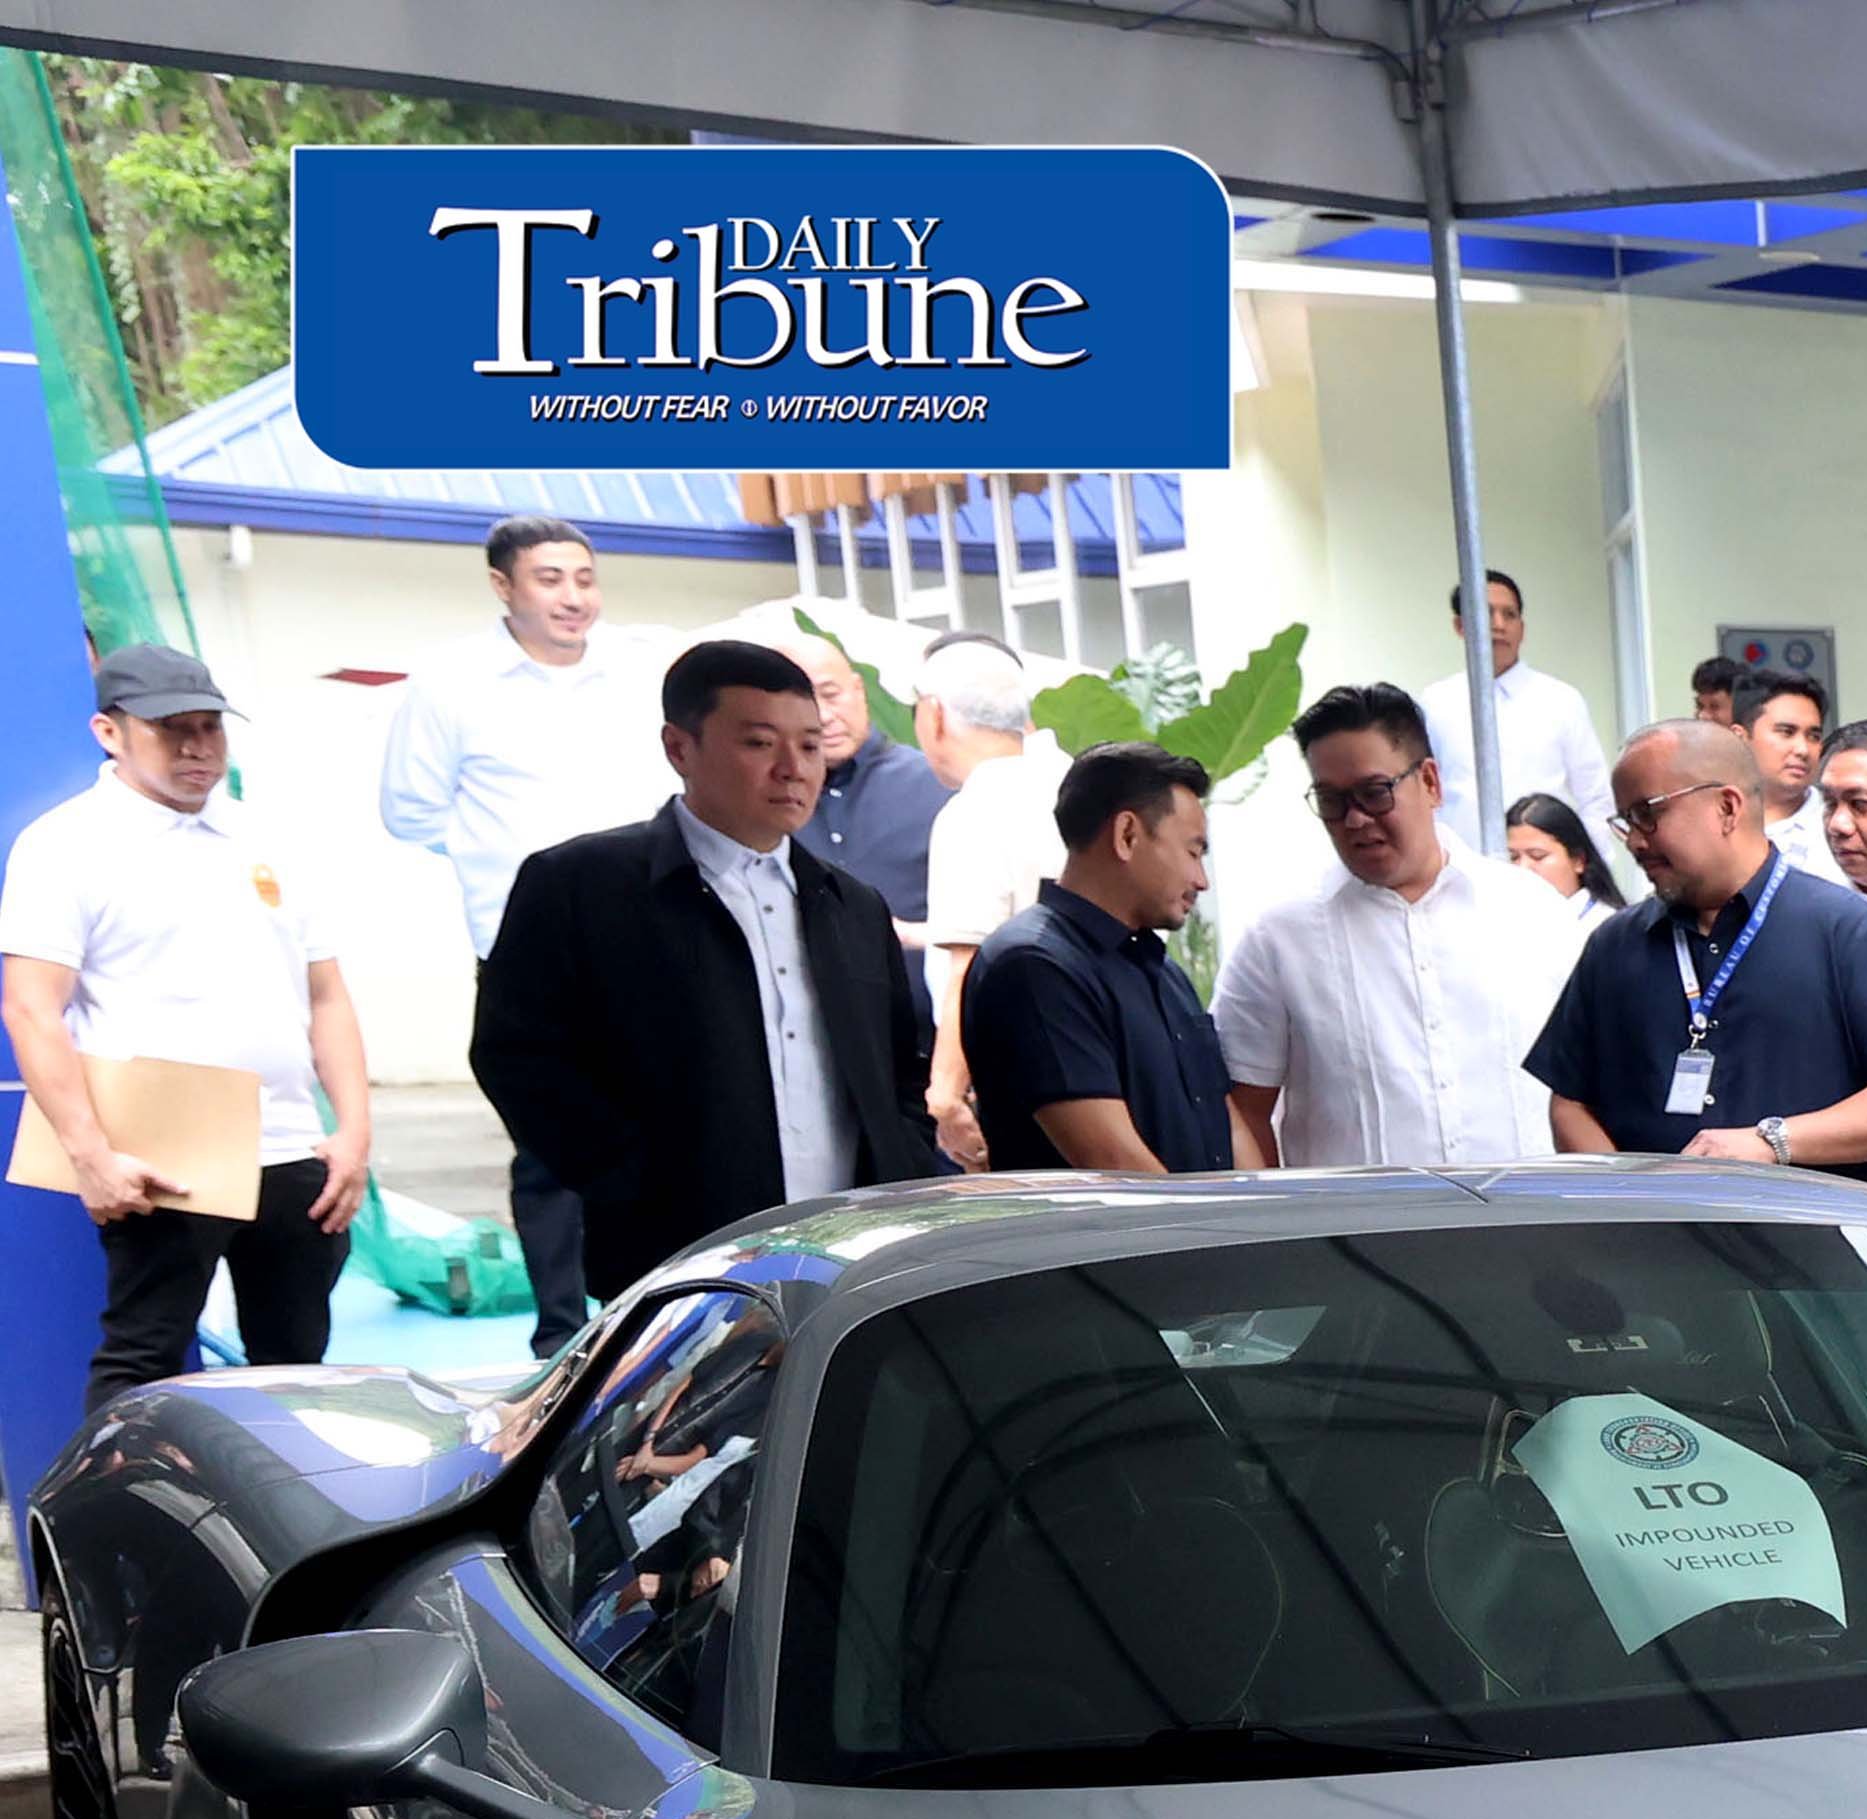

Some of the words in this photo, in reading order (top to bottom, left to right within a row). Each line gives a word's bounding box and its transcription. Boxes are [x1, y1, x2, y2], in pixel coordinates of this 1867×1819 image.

[1633, 1481, 1729, 1510] LTO
[1615, 1520, 1795, 1549] IMPOUNDED
[1662, 1549, 1782, 1573] VEHICLE
